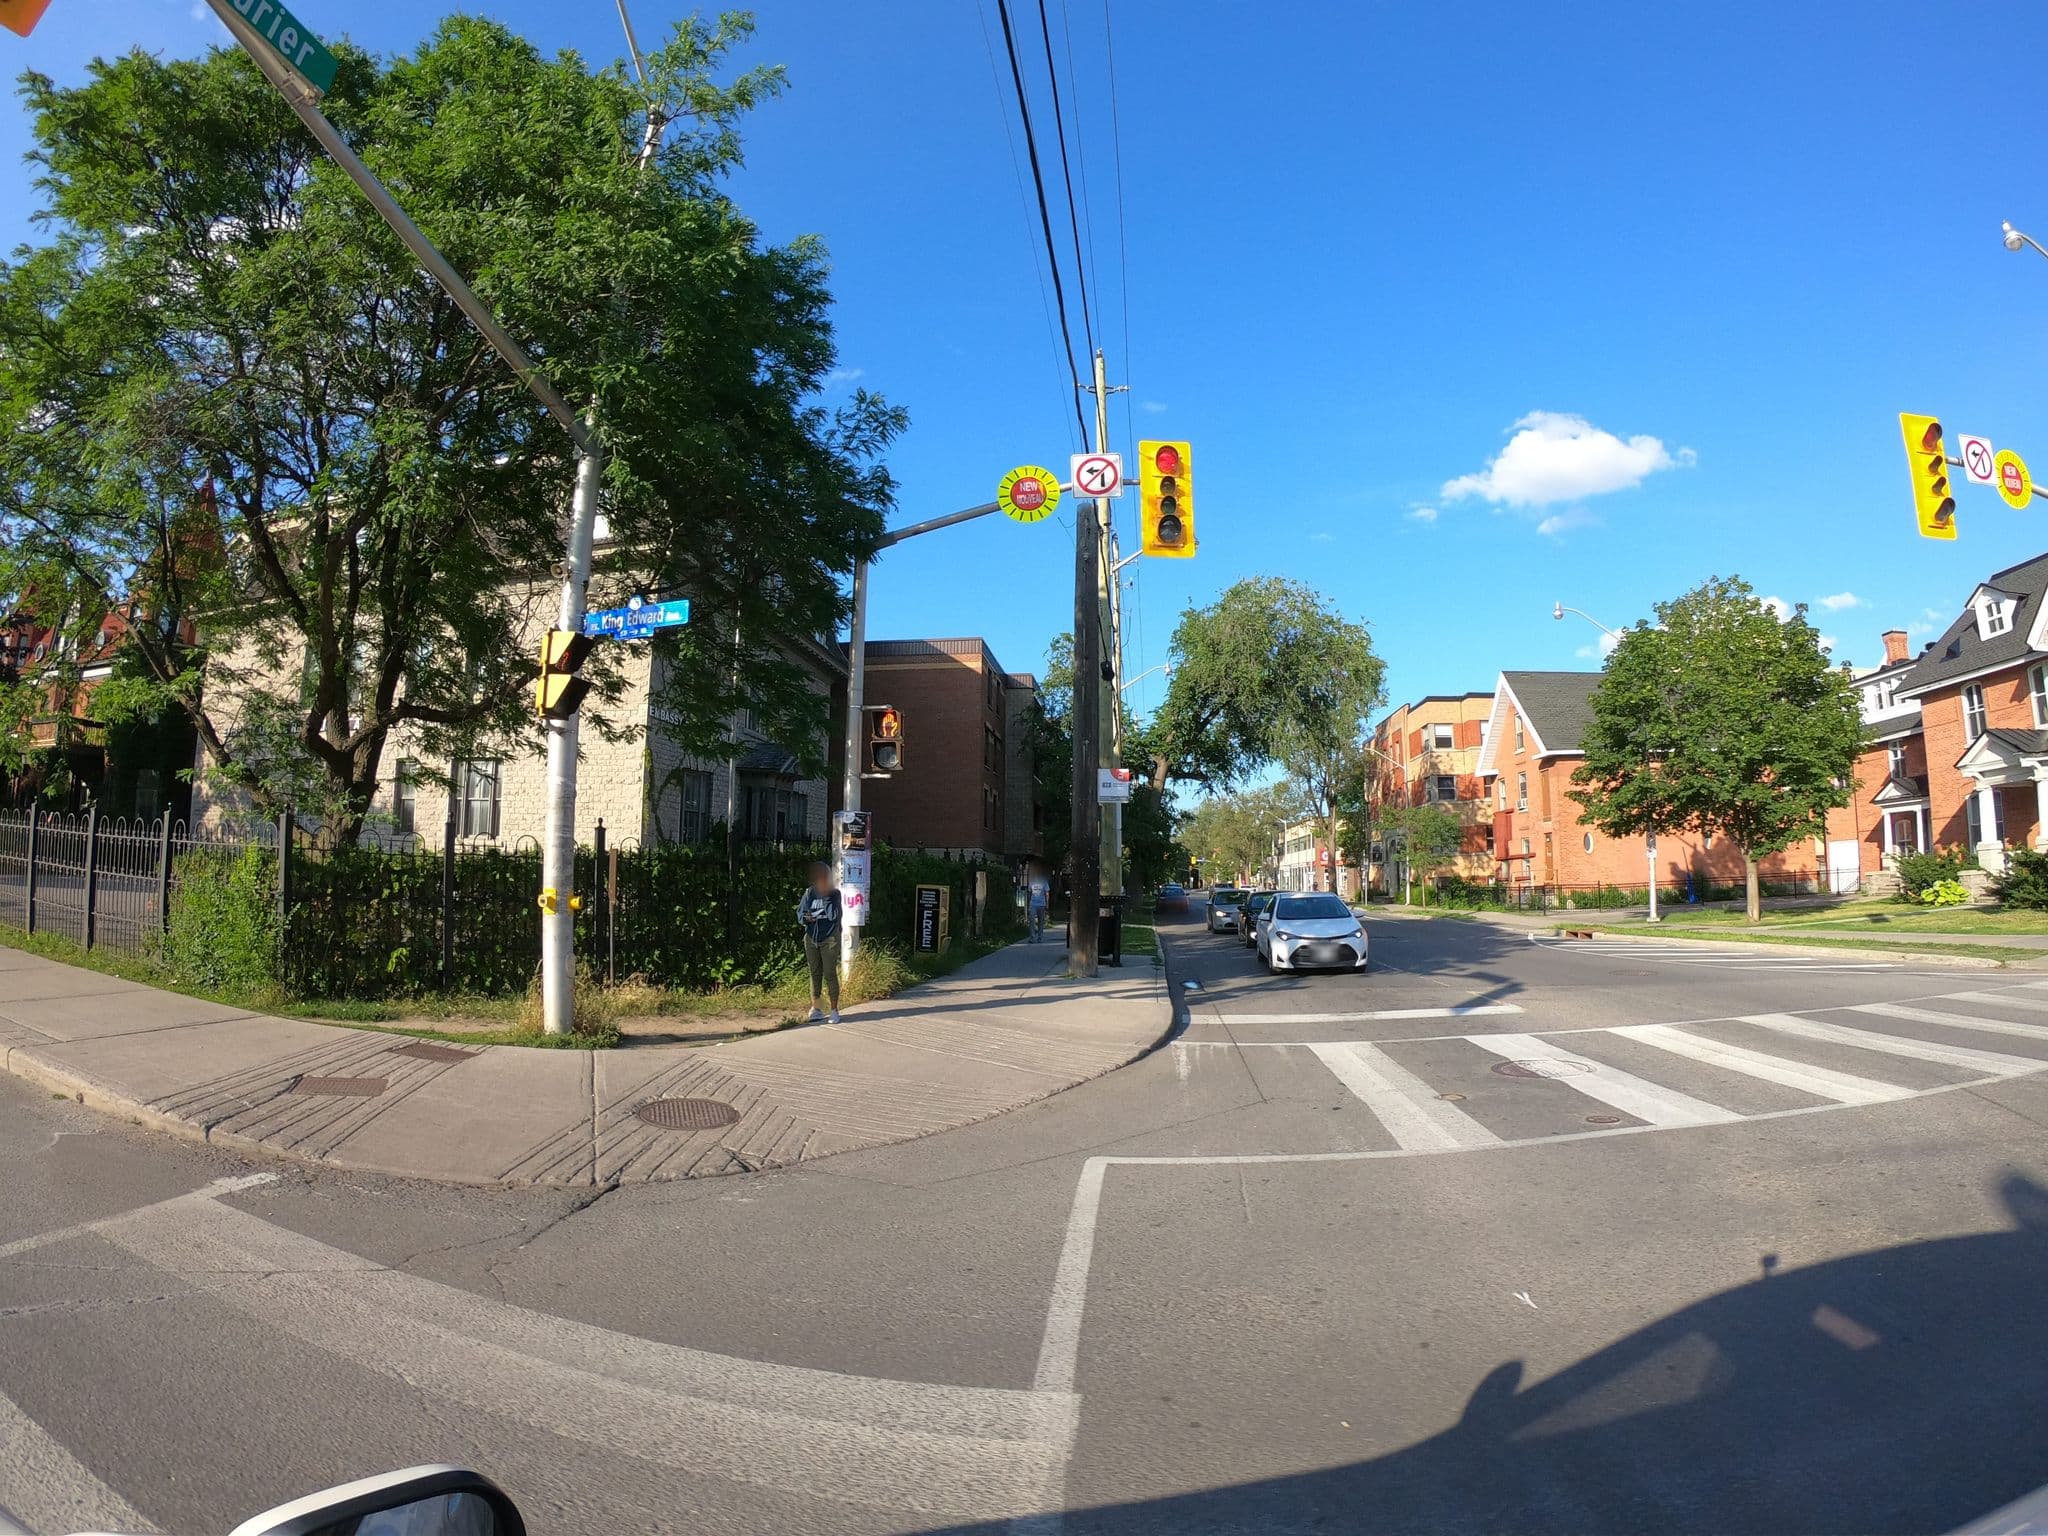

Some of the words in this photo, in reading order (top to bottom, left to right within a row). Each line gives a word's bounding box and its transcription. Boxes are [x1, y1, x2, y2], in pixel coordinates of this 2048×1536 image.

[1020, 481, 1038, 492] NEW
[601, 614, 624, 631] King
[627, 607, 665, 626] Edward
[922, 910, 933, 948] FREE
